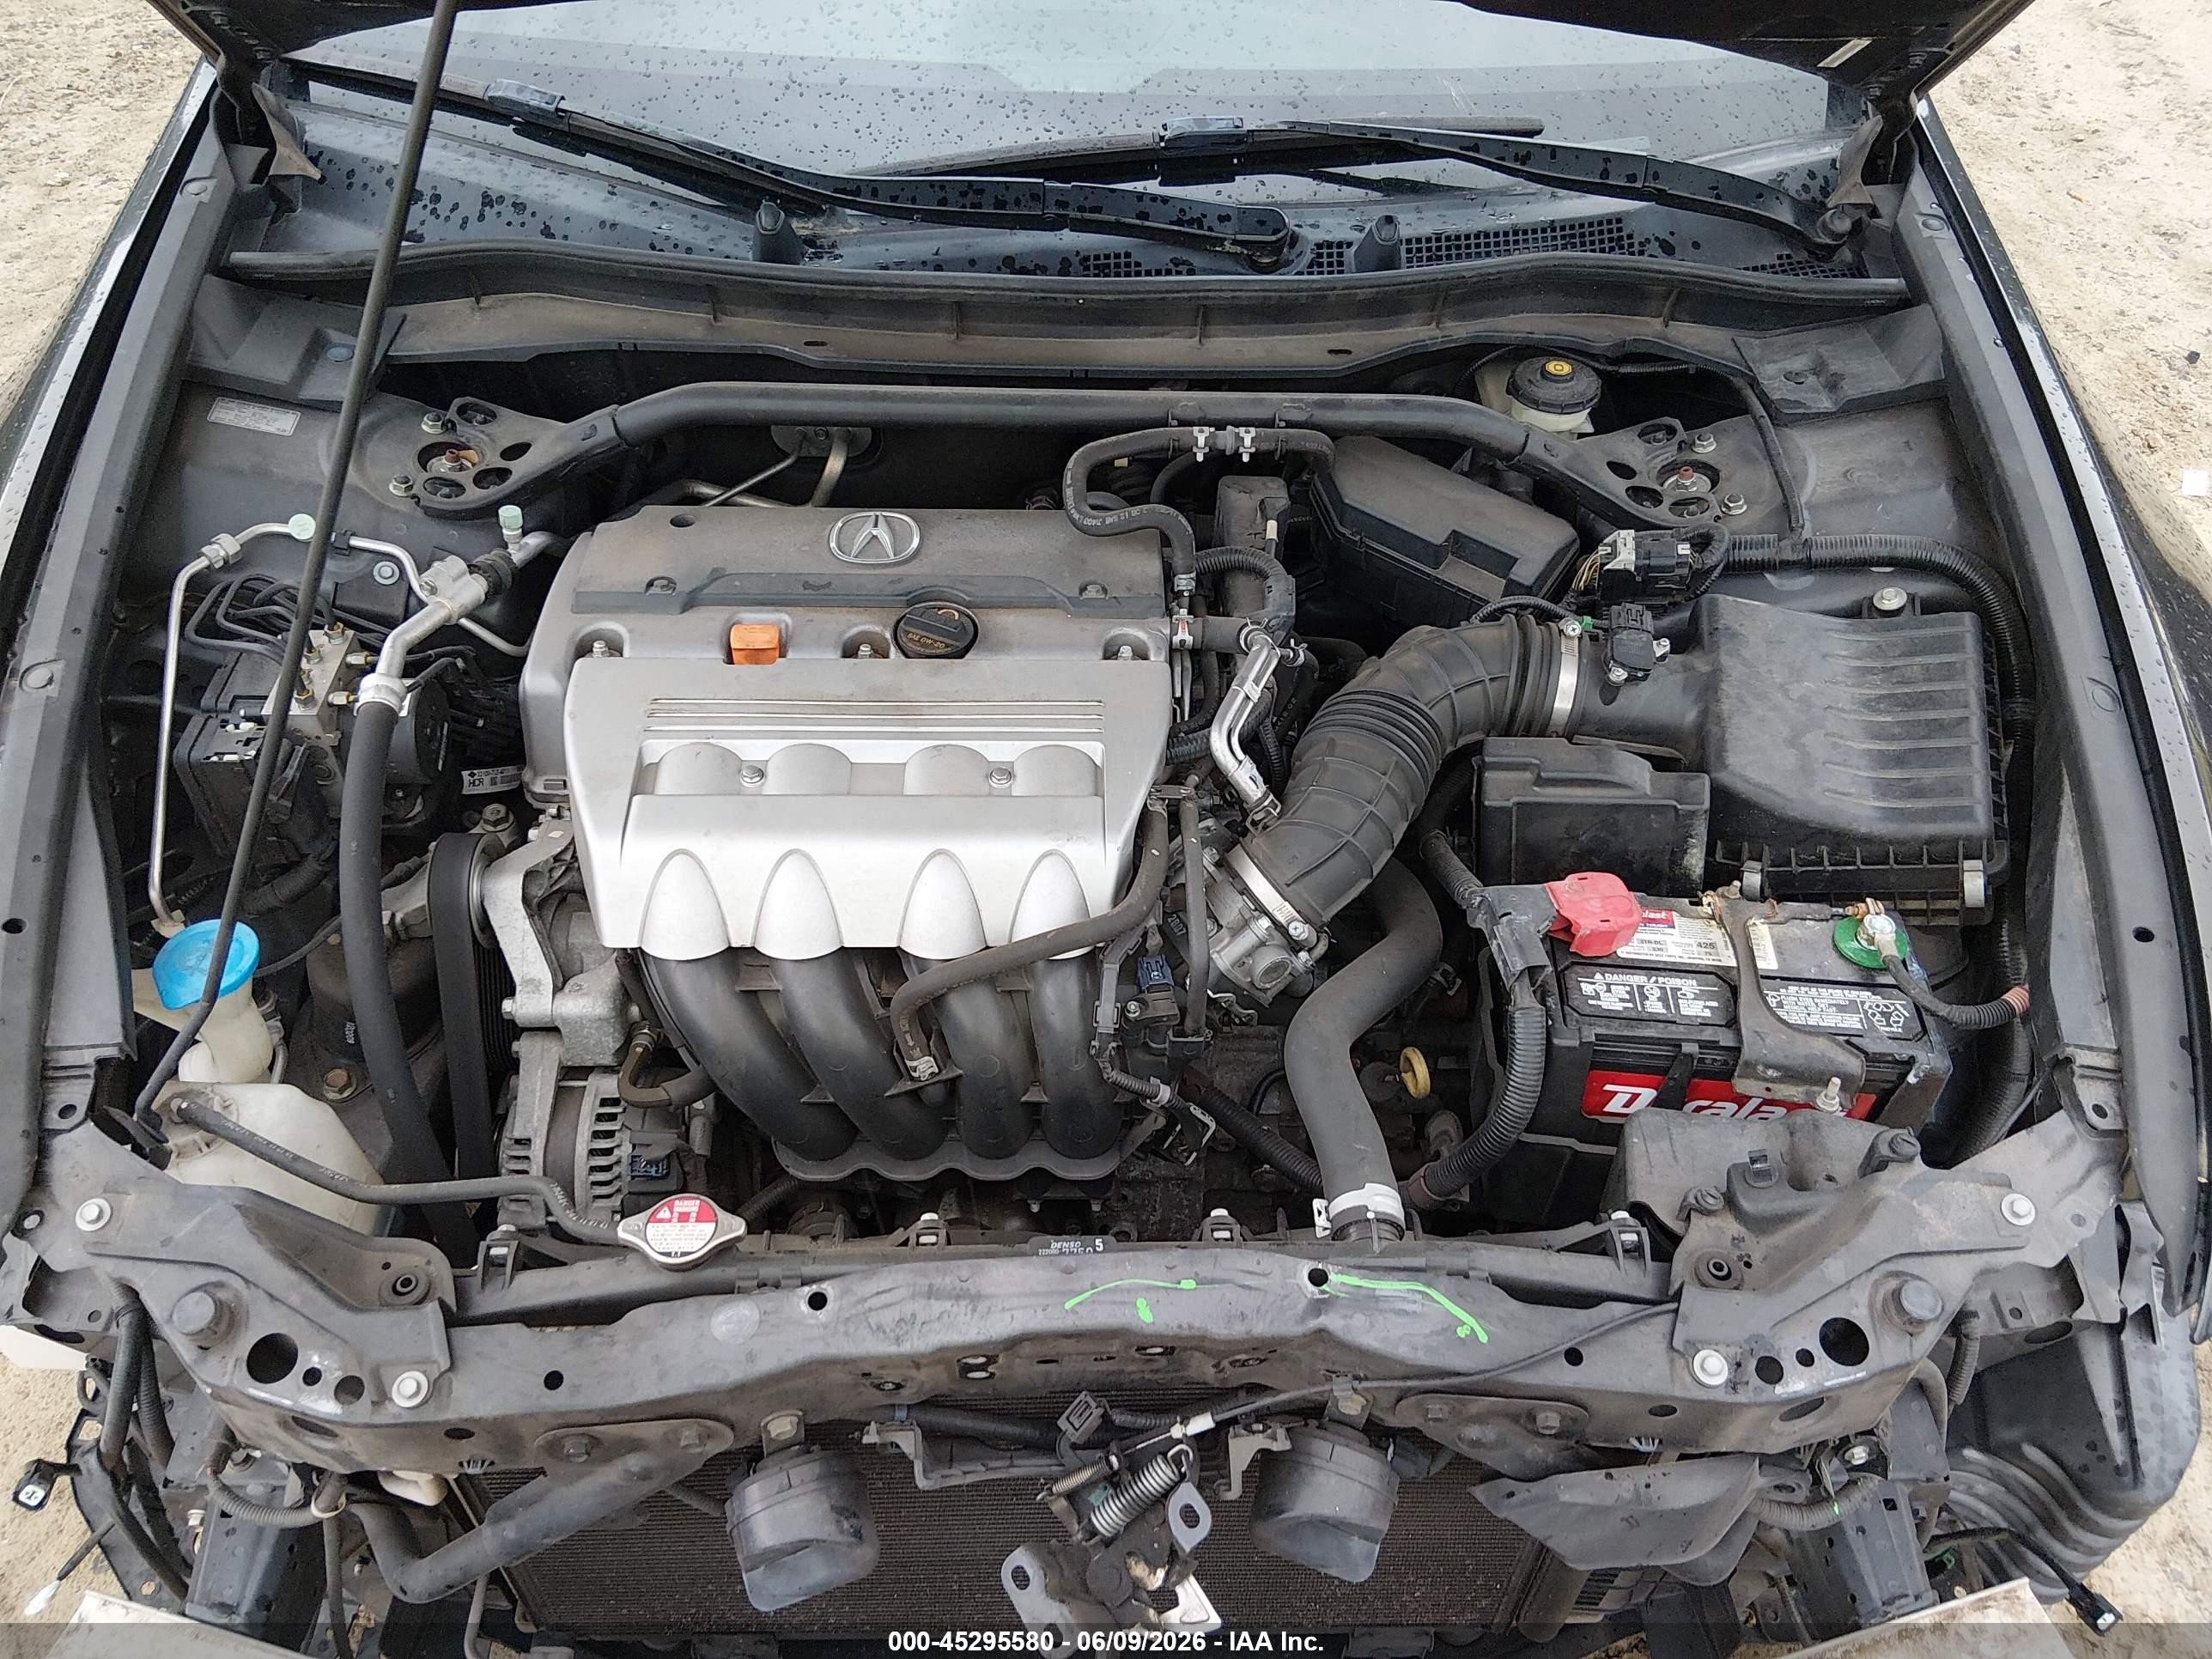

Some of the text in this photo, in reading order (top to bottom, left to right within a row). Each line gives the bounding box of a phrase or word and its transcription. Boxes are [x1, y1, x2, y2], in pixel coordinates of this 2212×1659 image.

[1696, 941, 1716, 950] 425
[1604, 972, 1648, 983] DANGER
[1657, 975, 1698, 987] POISON
[1050, 1237, 1104, 1252] DENSO 5
